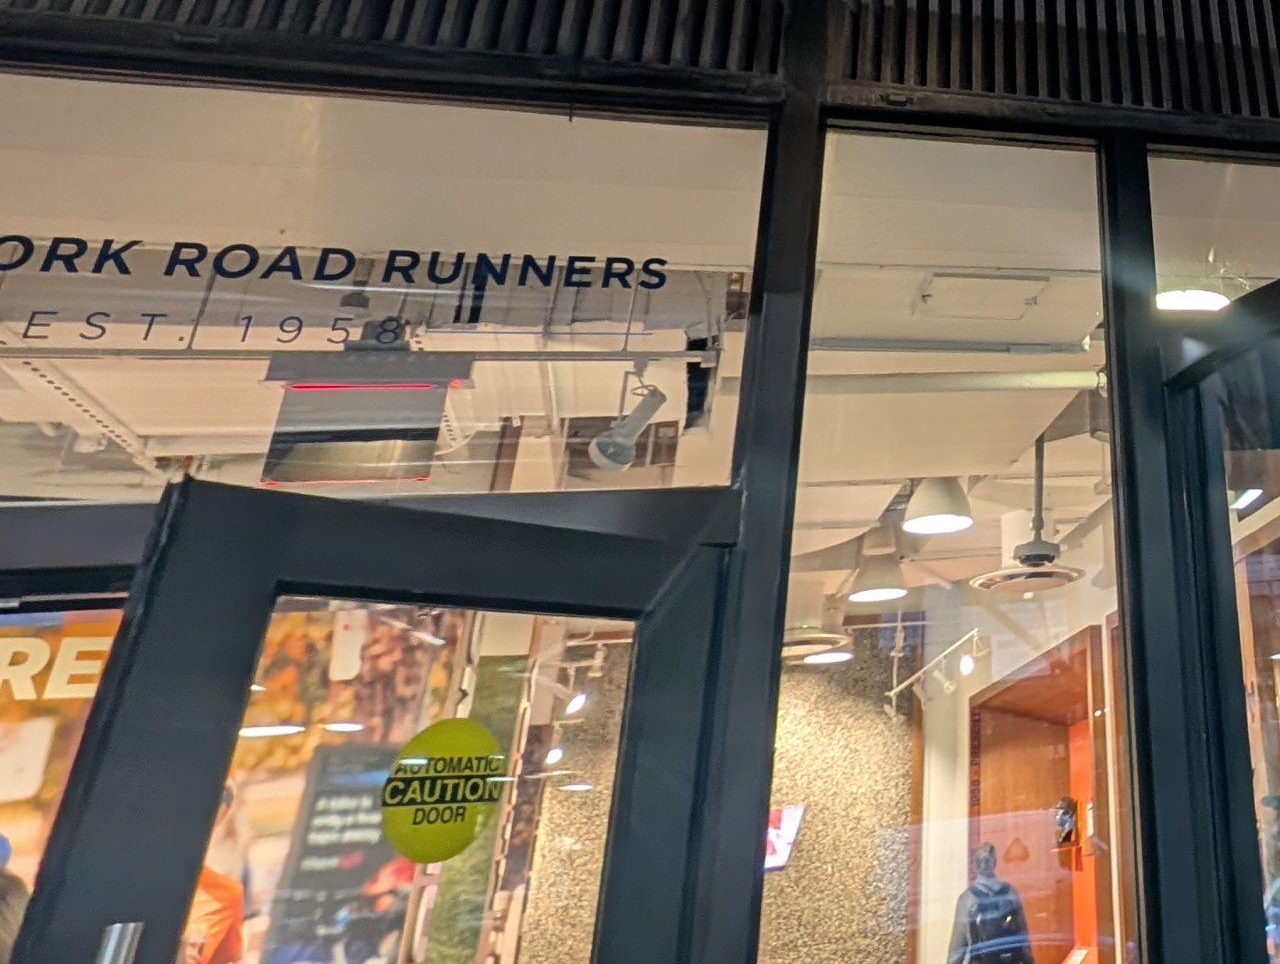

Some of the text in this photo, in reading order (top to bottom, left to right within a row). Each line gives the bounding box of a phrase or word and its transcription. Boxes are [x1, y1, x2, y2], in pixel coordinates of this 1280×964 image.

[0, 234, 668, 290] ORK ROAD RUNNERS
[22, 311, 404, 346] EST. 1958
[395, 756, 500, 775] AUTOMATIC
[384, 778, 500, 804] CAUTION
[412, 806, 466, 825] DOOR
